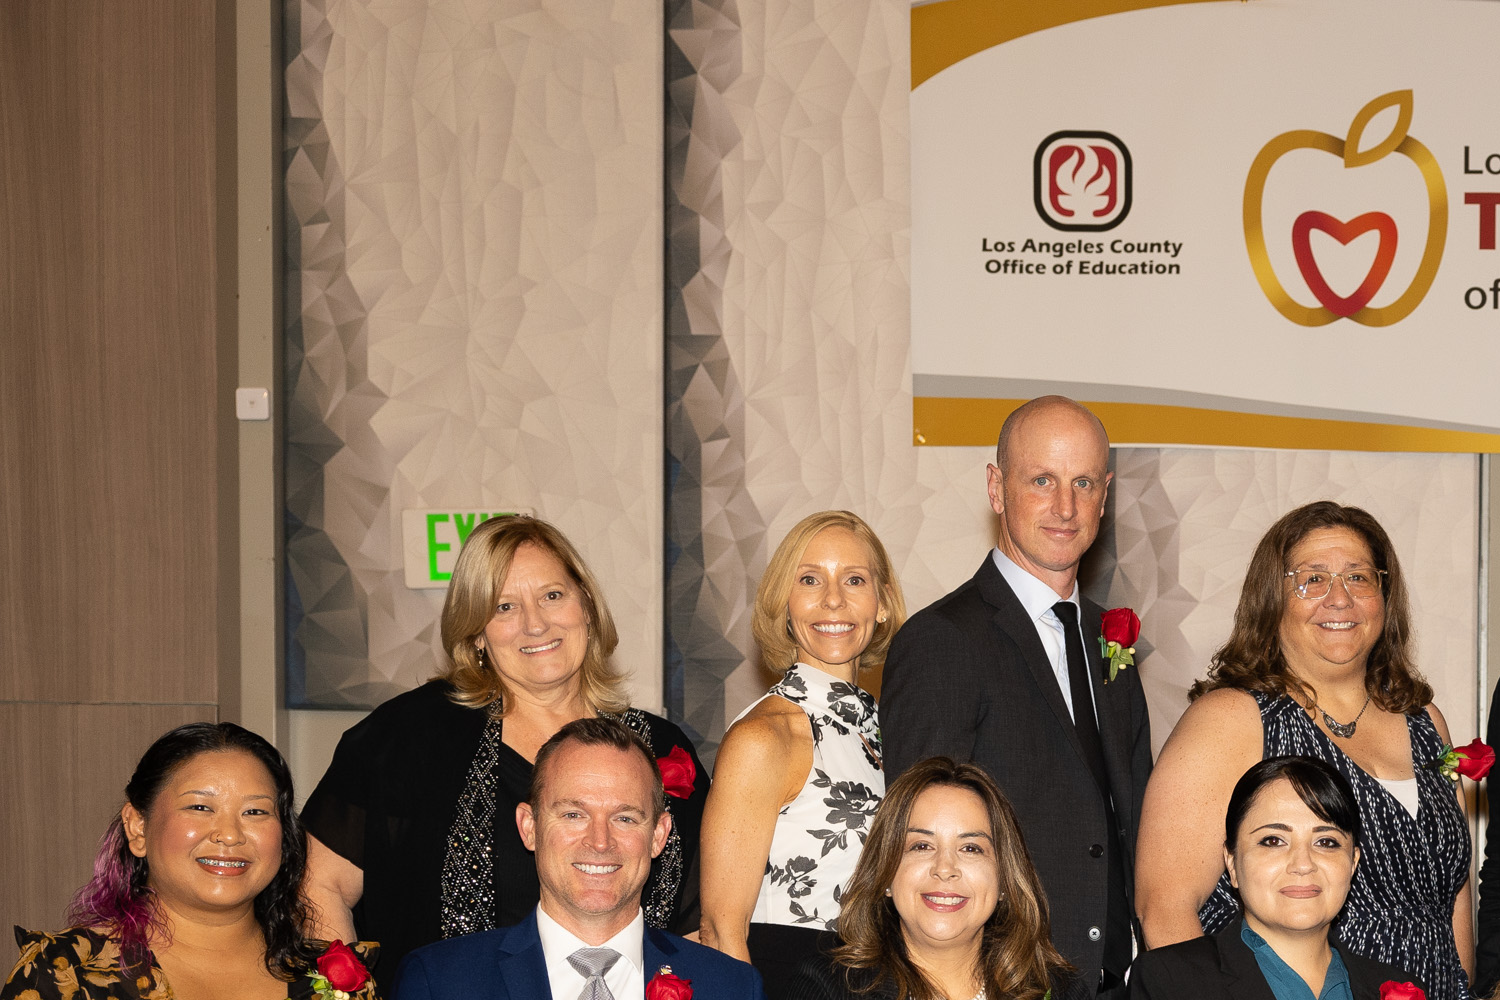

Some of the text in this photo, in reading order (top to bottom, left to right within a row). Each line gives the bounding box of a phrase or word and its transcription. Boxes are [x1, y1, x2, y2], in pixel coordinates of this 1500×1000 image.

[981, 237, 1183, 258] Los Angeles County
[984, 259, 1181, 275] Office of Education
